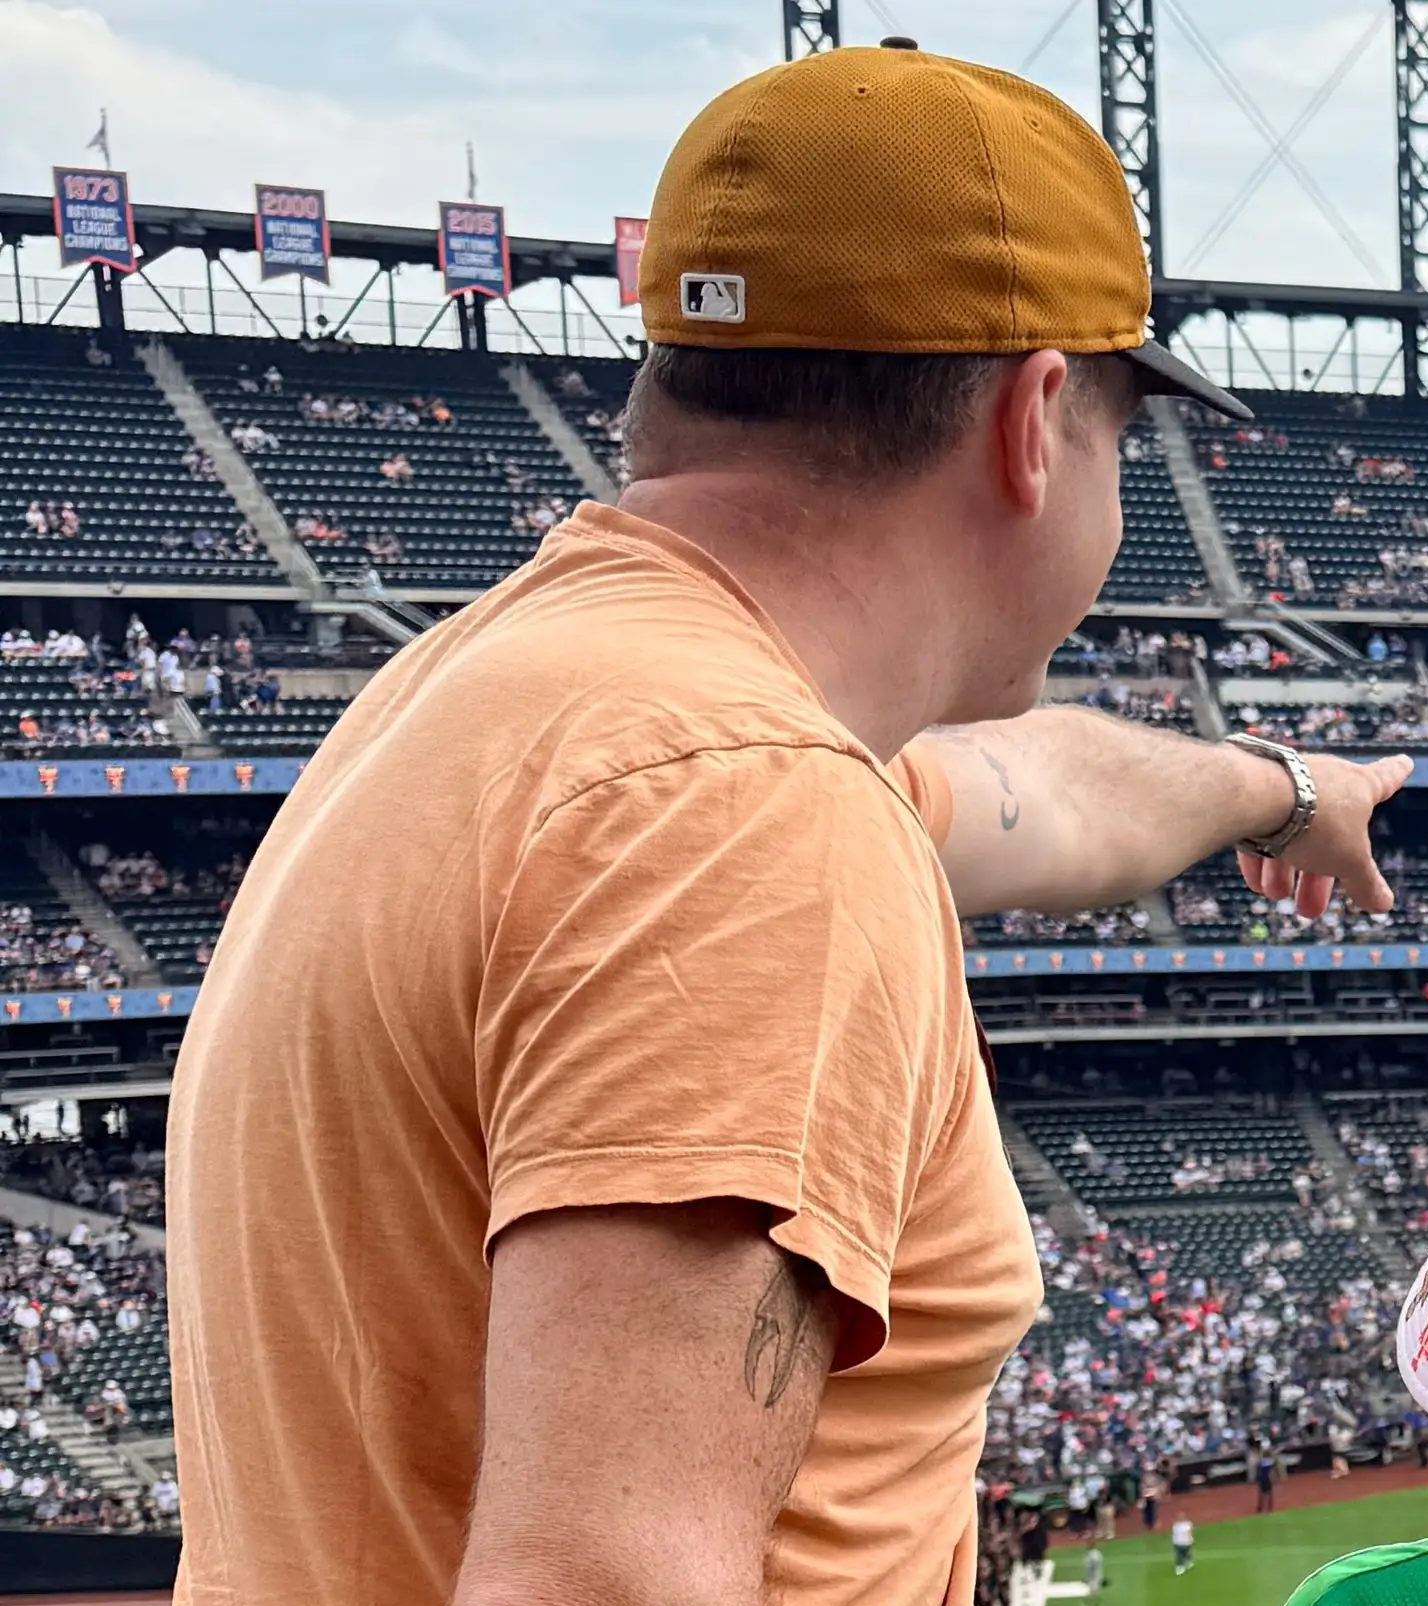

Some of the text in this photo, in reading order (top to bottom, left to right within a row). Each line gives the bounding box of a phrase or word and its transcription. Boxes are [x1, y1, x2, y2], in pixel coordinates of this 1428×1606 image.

[63, 174, 119, 202] 1973
[66, 204, 122, 222] NATIONAL
[261, 192, 319, 219] 2000
[72, 219, 117, 236] LEAGUE
[447, 210, 498, 236] 2015
[64, 232, 128, 251] CHAMPIONS
